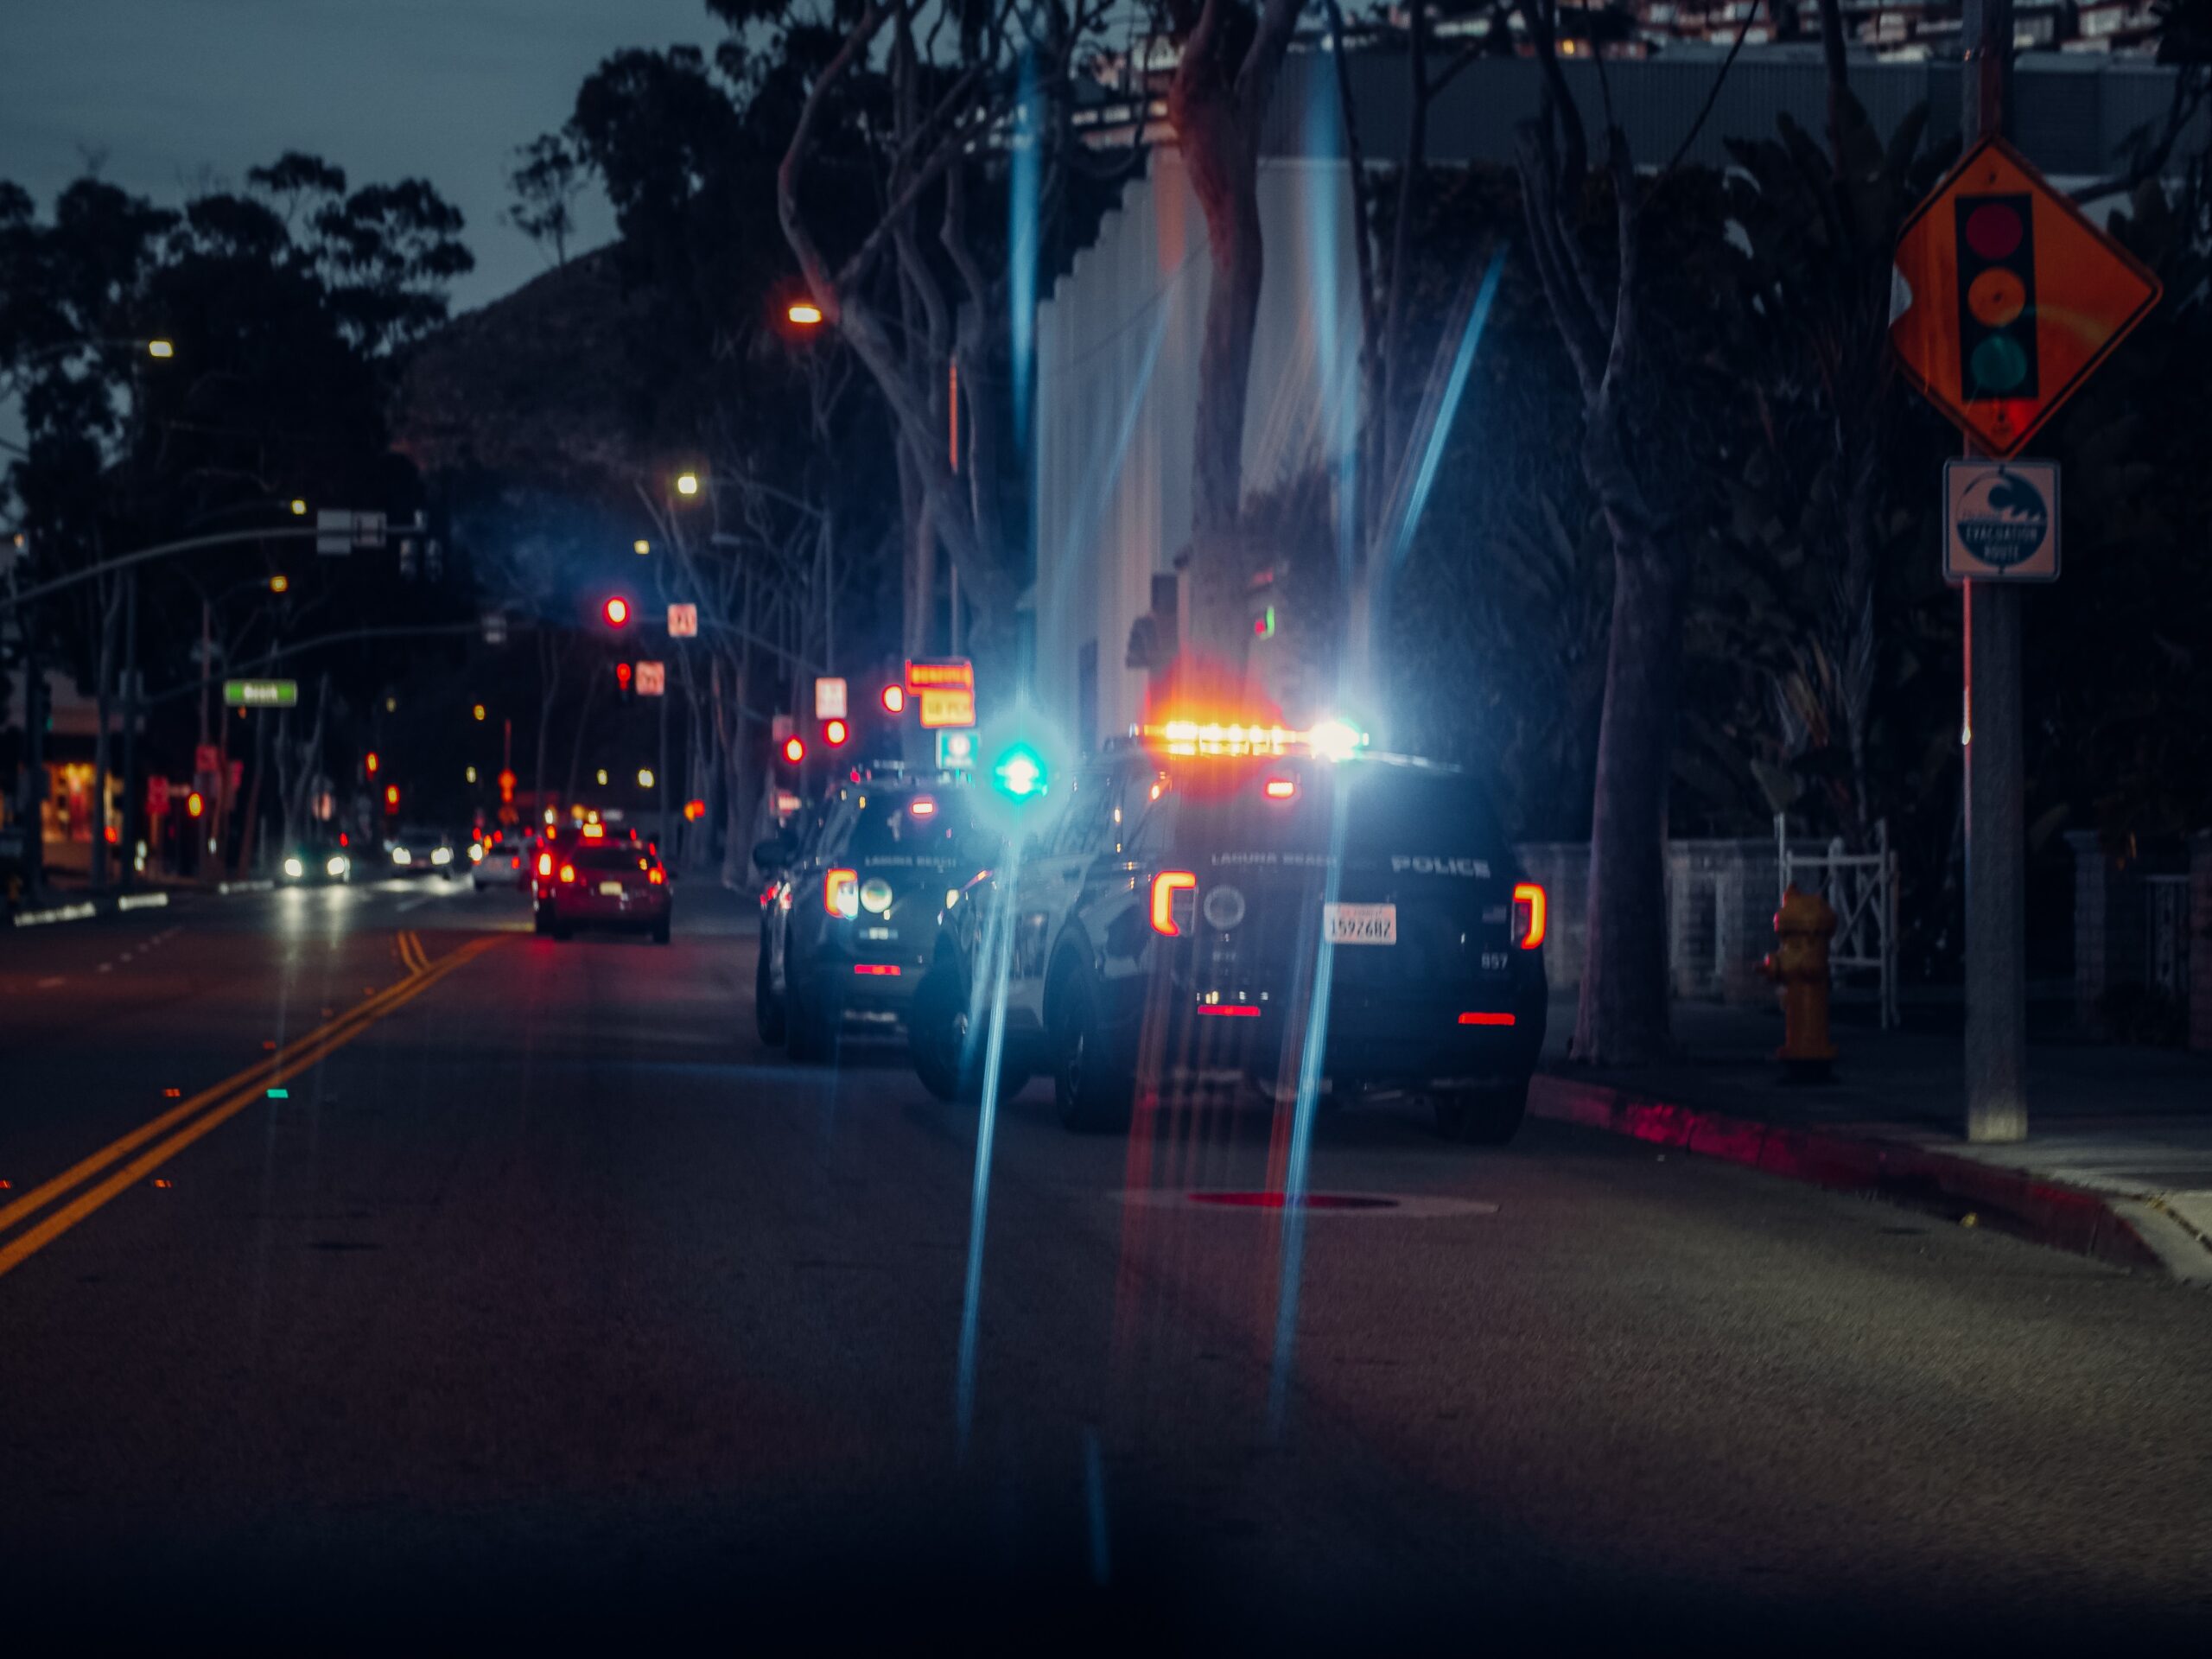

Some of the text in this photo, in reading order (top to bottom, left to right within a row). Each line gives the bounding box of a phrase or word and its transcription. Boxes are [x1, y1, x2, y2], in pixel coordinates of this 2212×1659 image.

[1966, 525, 2037, 543] EVACUATION
[1983, 545, 2019, 562] ROUTE
[1390, 855, 1491, 879] POLICE
[1480, 952, 1508, 970] 857
